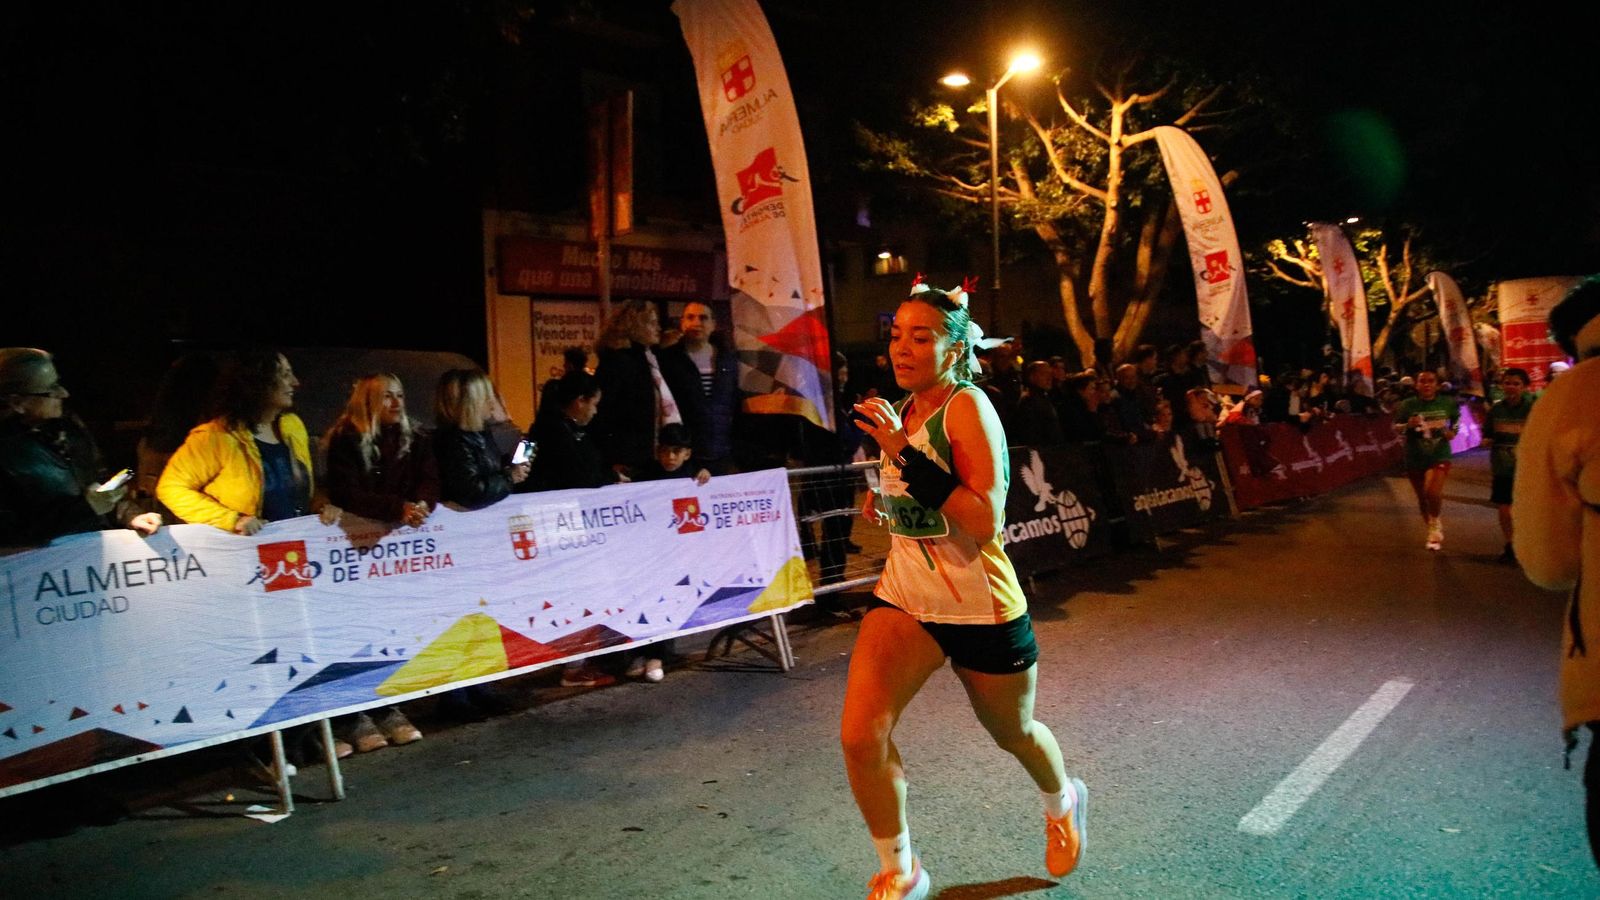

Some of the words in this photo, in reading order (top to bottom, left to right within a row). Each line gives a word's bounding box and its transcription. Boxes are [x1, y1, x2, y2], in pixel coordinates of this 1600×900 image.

[561, 245, 621, 269] Muco
[517, 268, 553, 289] que
[560, 269, 593, 288] una
[533, 310, 595, 325] Pensando
[535, 326, 580, 340] Vender
[582, 327, 595, 340] tu
[556, 499, 647, 532] ALMERÍA
[712, 498, 773, 517] DEPORTES
[716, 516, 733, 529] DE
[735, 509, 781, 526] ALMERIA
[559, 532, 607, 551] CIUDAD
[1002, 514, 1061, 546] acamos
[329, 538, 436, 565] DEPORTES
[35, 548, 207, 601] ALMERÍA
[332, 565, 360, 583] DE
[367, 553, 454, 578] ALMERIA
[36, 595, 130, 625] CIUDAD
